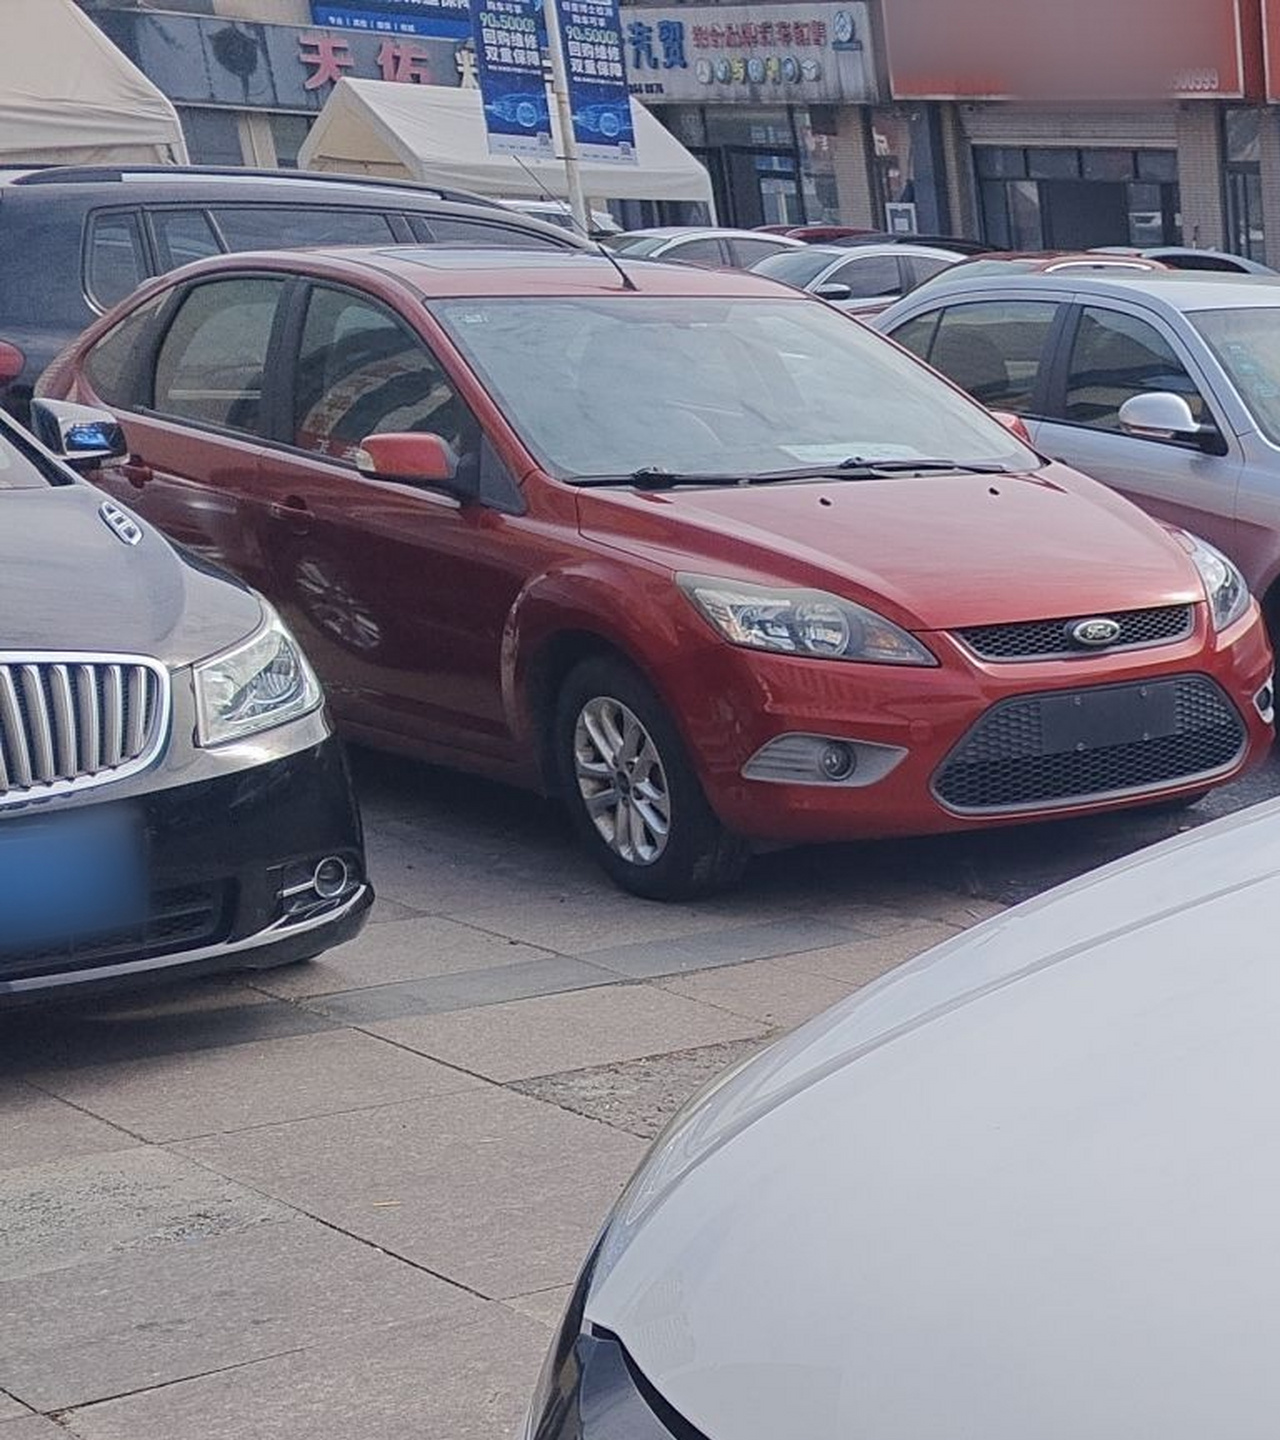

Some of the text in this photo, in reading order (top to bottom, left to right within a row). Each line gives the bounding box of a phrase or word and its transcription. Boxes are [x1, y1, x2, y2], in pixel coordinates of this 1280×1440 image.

[482, 28, 538, 49] 回购维修
[484, 46, 541, 67] 双重保障
[568, 41, 620, 61] 回购维修
[570, 58, 623, 78] 双重保障
